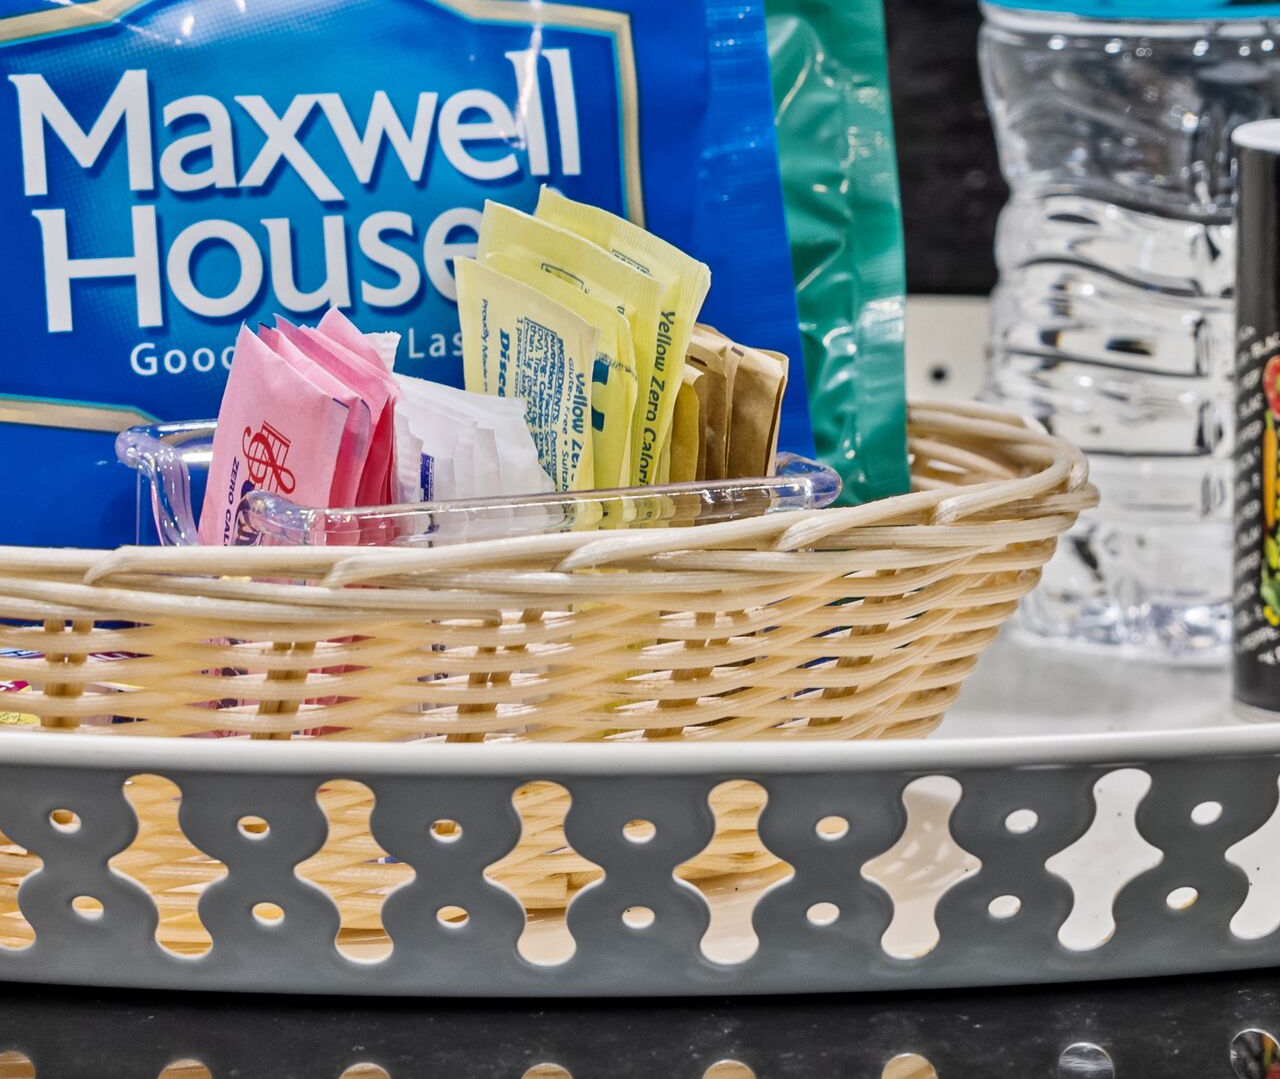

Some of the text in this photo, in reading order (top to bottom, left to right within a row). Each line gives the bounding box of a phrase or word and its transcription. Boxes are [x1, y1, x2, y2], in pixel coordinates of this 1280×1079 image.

[8, 48, 582, 202] Maxwell
[32, 206, 482, 333] House
[547, 334, 557, 389] Nutrition
[655, 311, 676, 372] Yellow
[552, 338, 566, 424] INGREDIENTS:
[565, 357, 575, 401] Gluten
[561, 406, 571, 434] Free
[228, 456, 241, 506] ZERO
